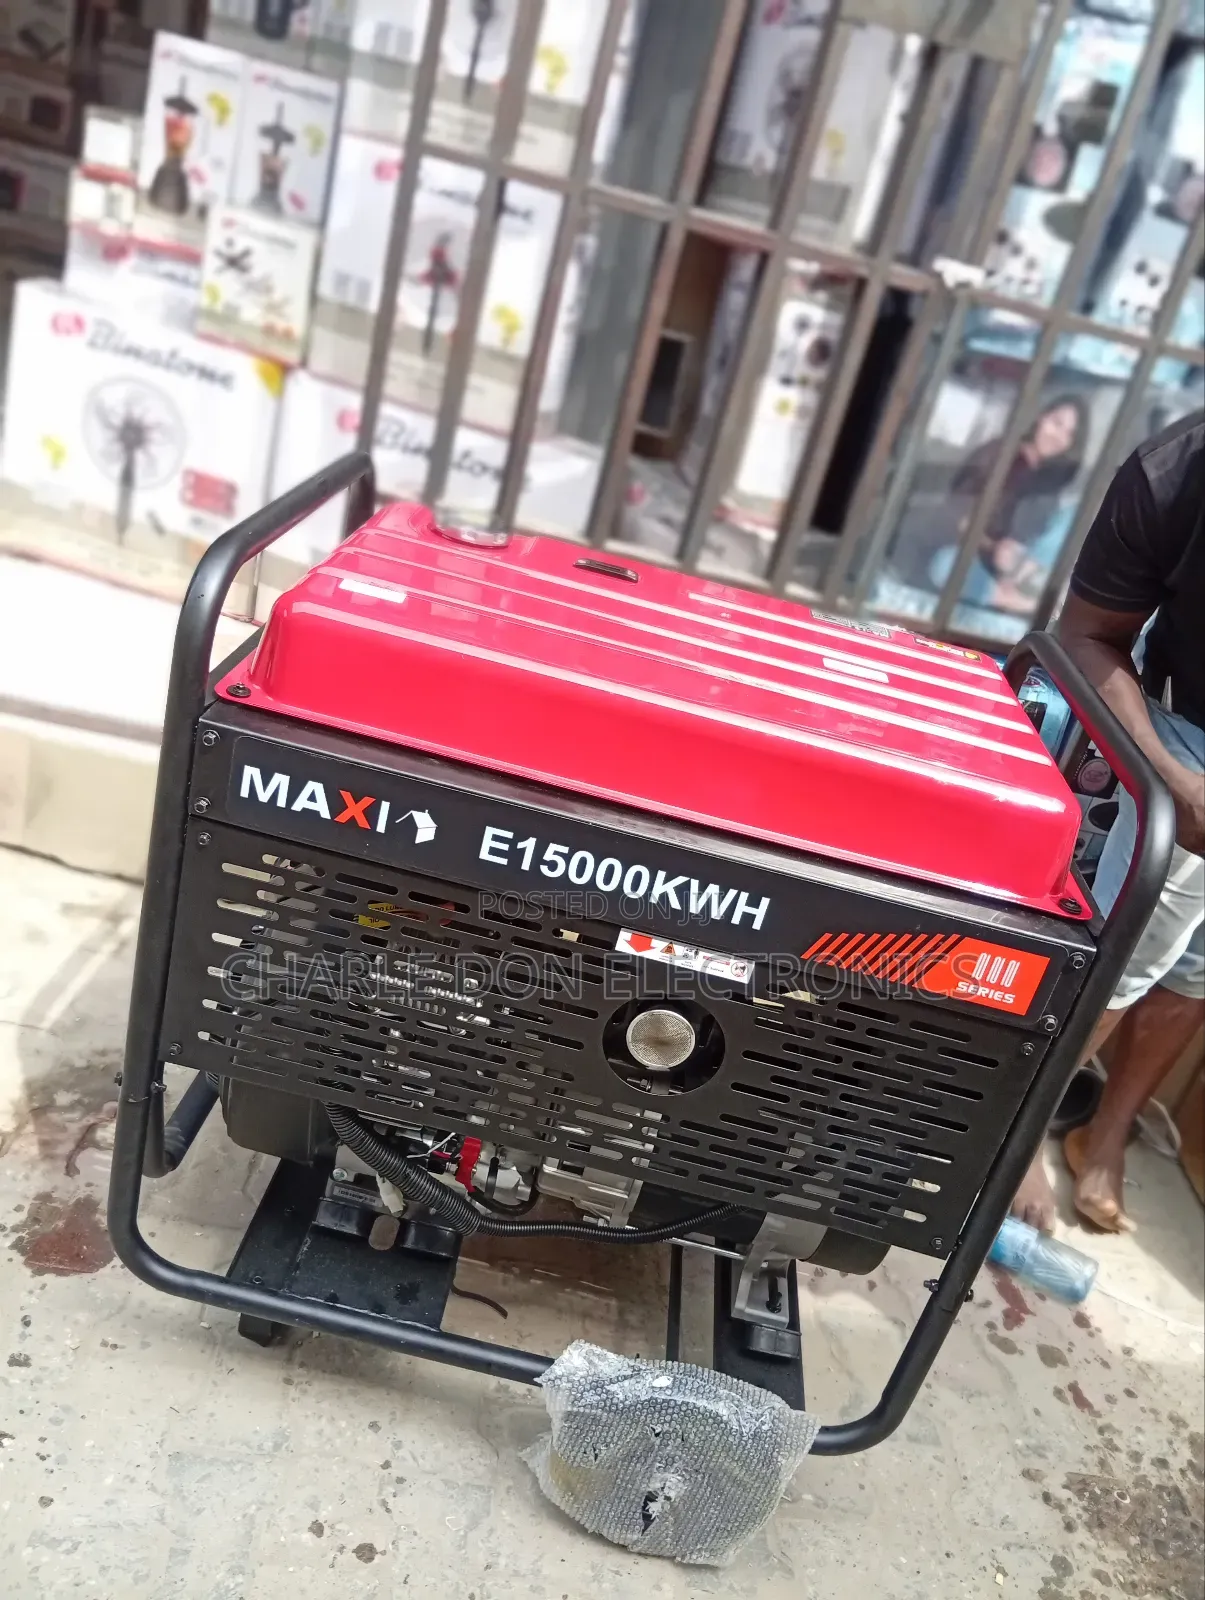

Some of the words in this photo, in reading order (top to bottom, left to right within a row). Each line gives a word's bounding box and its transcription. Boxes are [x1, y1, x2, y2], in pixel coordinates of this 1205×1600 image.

[240, 765, 390, 834] MAXI
[479, 826, 770, 931] E15000KWH
[956, 980, 1016, 1004] SERIES
